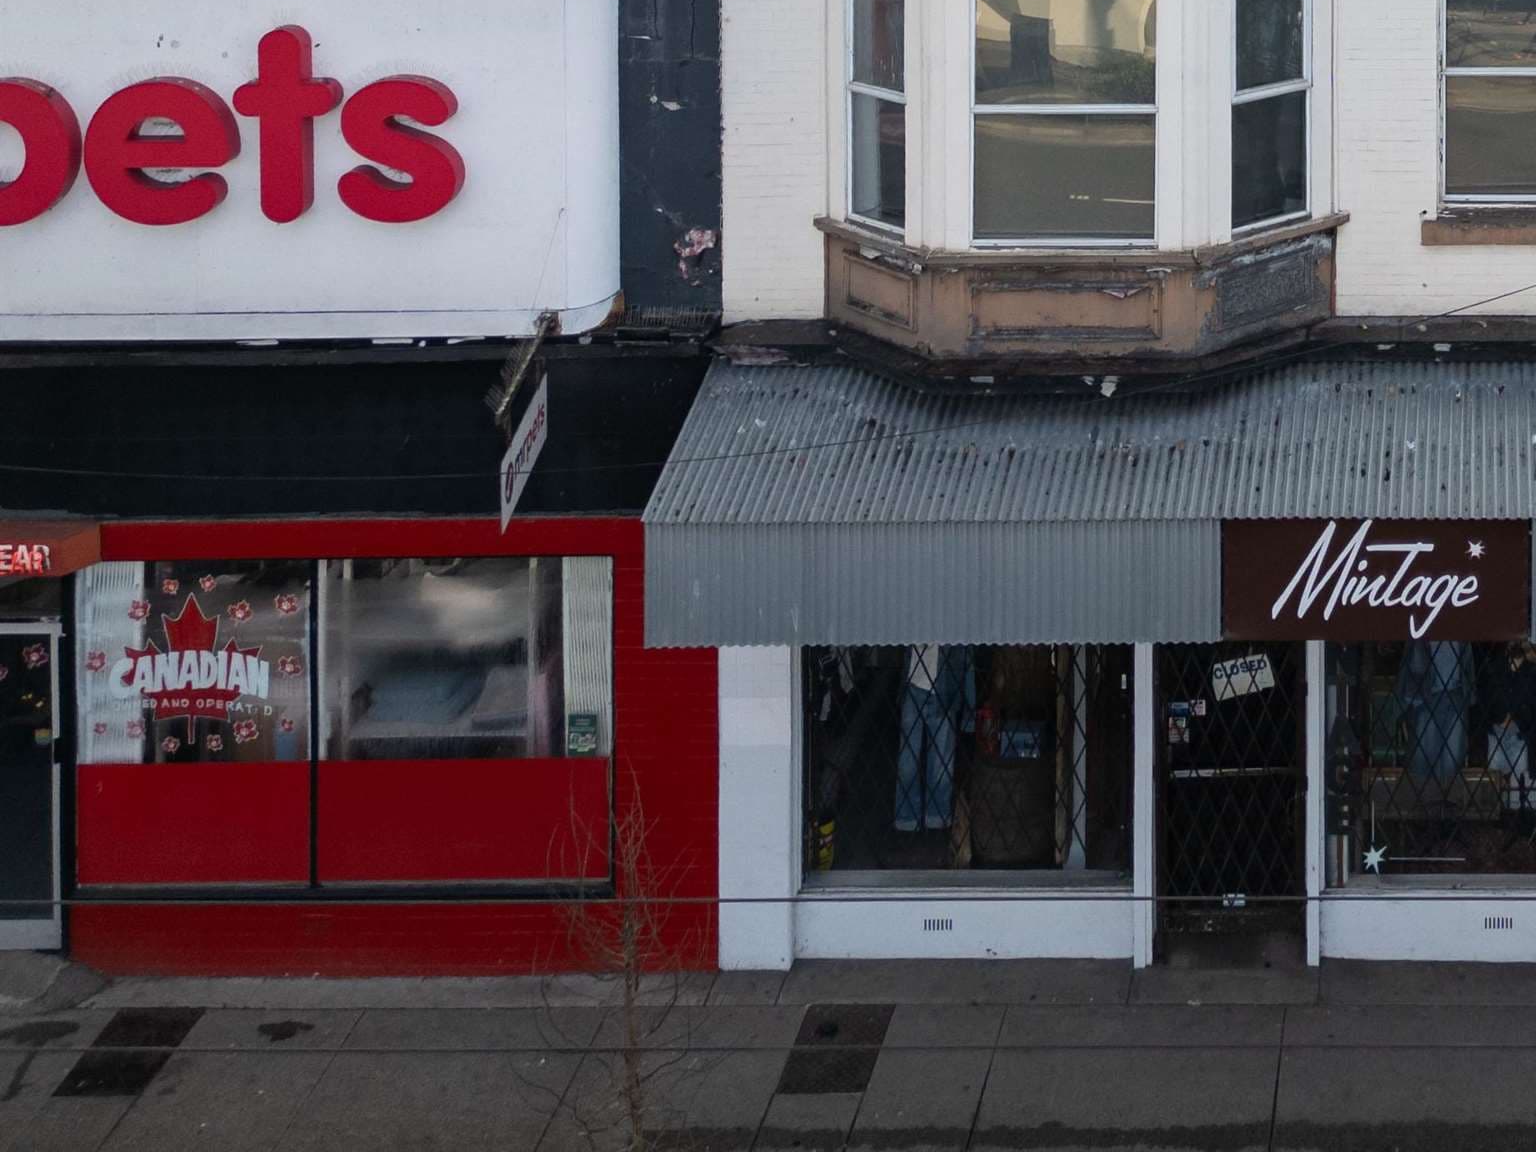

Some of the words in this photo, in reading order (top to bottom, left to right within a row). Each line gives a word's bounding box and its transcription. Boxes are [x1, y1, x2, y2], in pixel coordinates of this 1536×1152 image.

[109, 650, 270, 700] CANADIAN
[1214, 659, 1267, 679] CLOSED
[161, 698, 190, 709] AND
[195, 698, 273, 716] OPERATD
